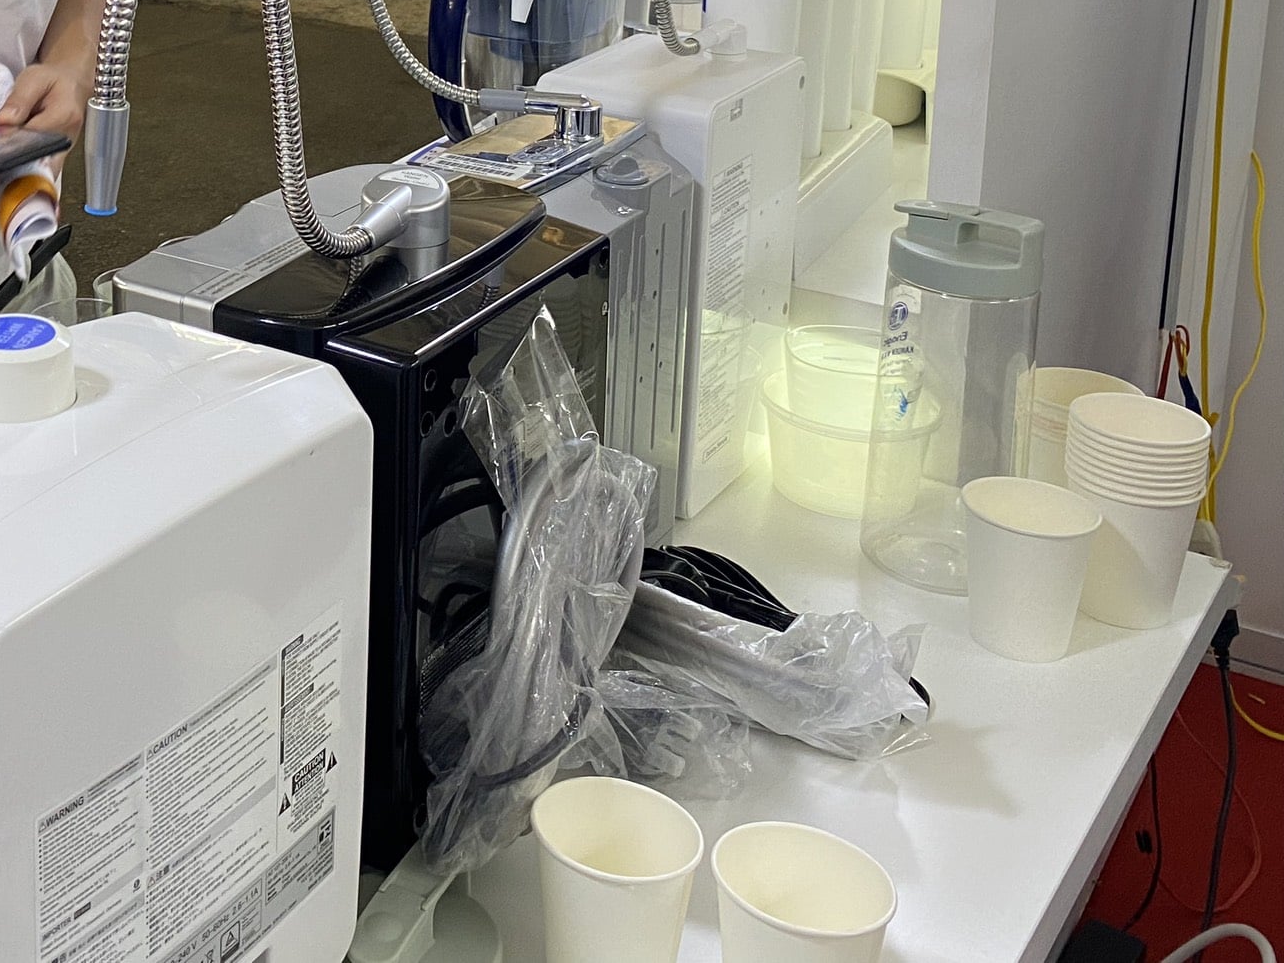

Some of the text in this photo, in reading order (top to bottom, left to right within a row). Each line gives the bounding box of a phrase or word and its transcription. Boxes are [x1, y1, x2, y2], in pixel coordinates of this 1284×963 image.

[153, 723, 189, 755] CAUTION
[294, 750, 324, 783] CAUTION
[45, 795, 85, 828] WARNING
